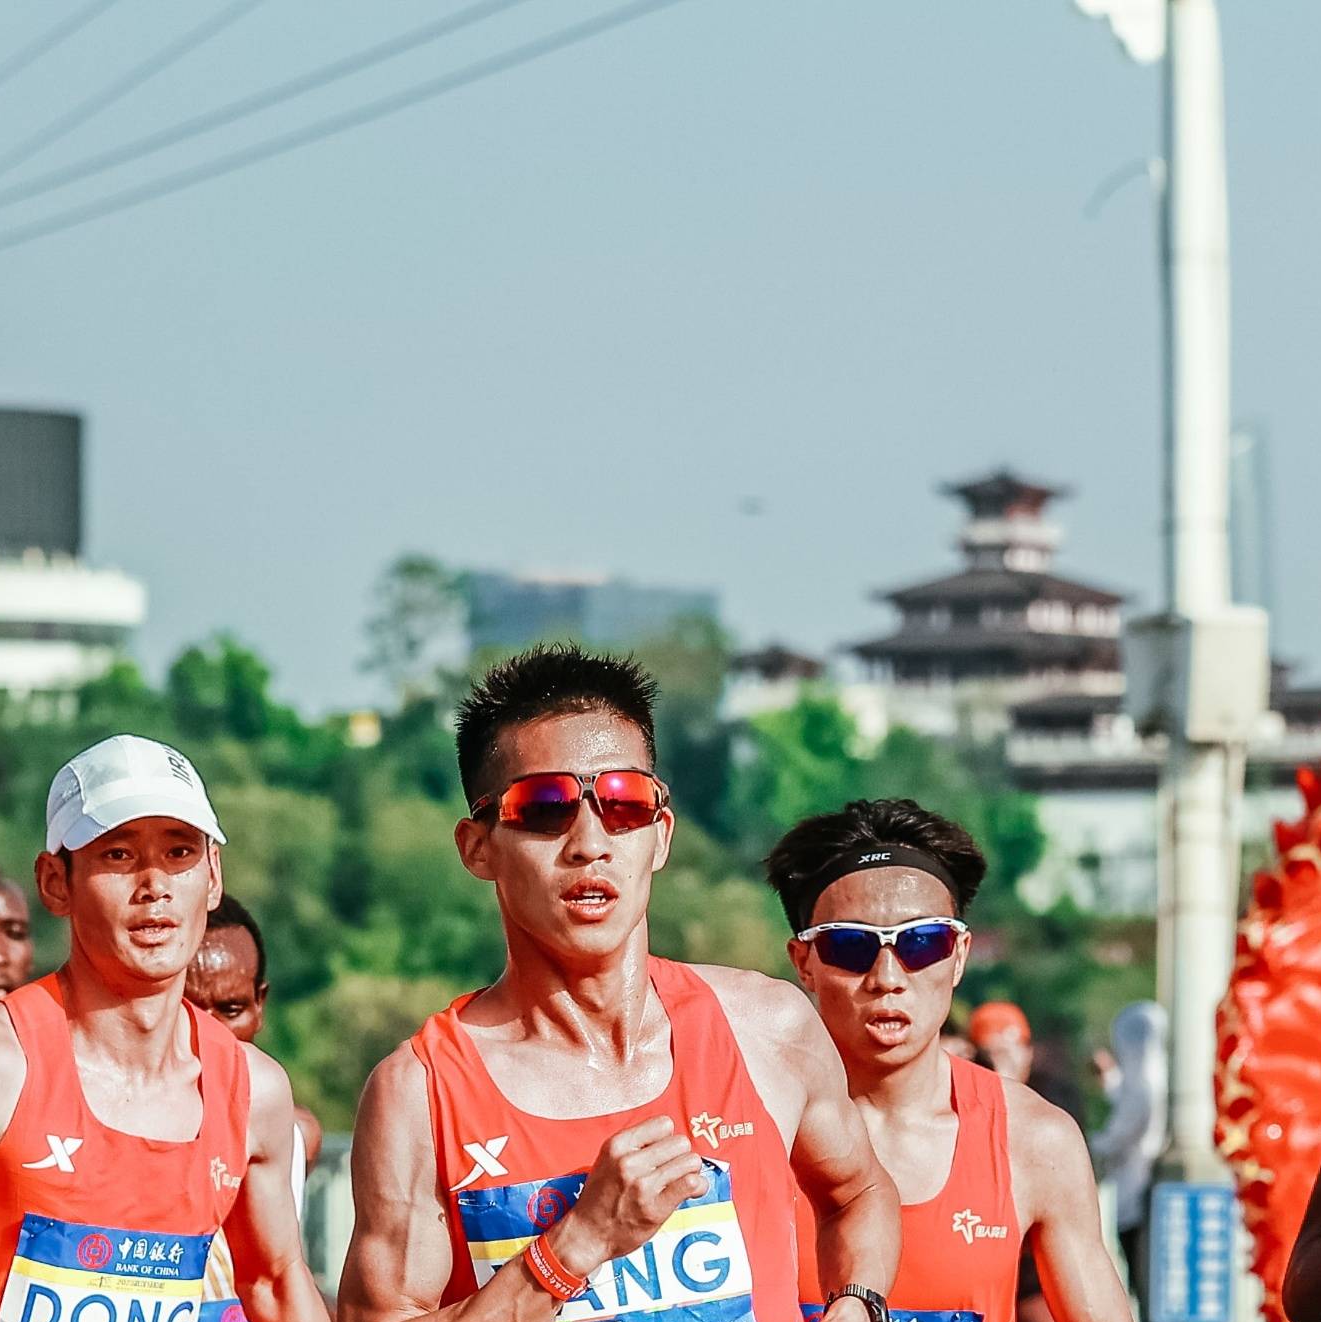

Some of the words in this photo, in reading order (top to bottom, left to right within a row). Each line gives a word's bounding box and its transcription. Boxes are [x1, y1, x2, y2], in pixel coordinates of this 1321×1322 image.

[858, 852, 891, 864] XRC
[115, 1262, 139, 1273] BANK
[140, 1265, 154, 1275] OF
[154, 1267, 180, 1277] CHINA
